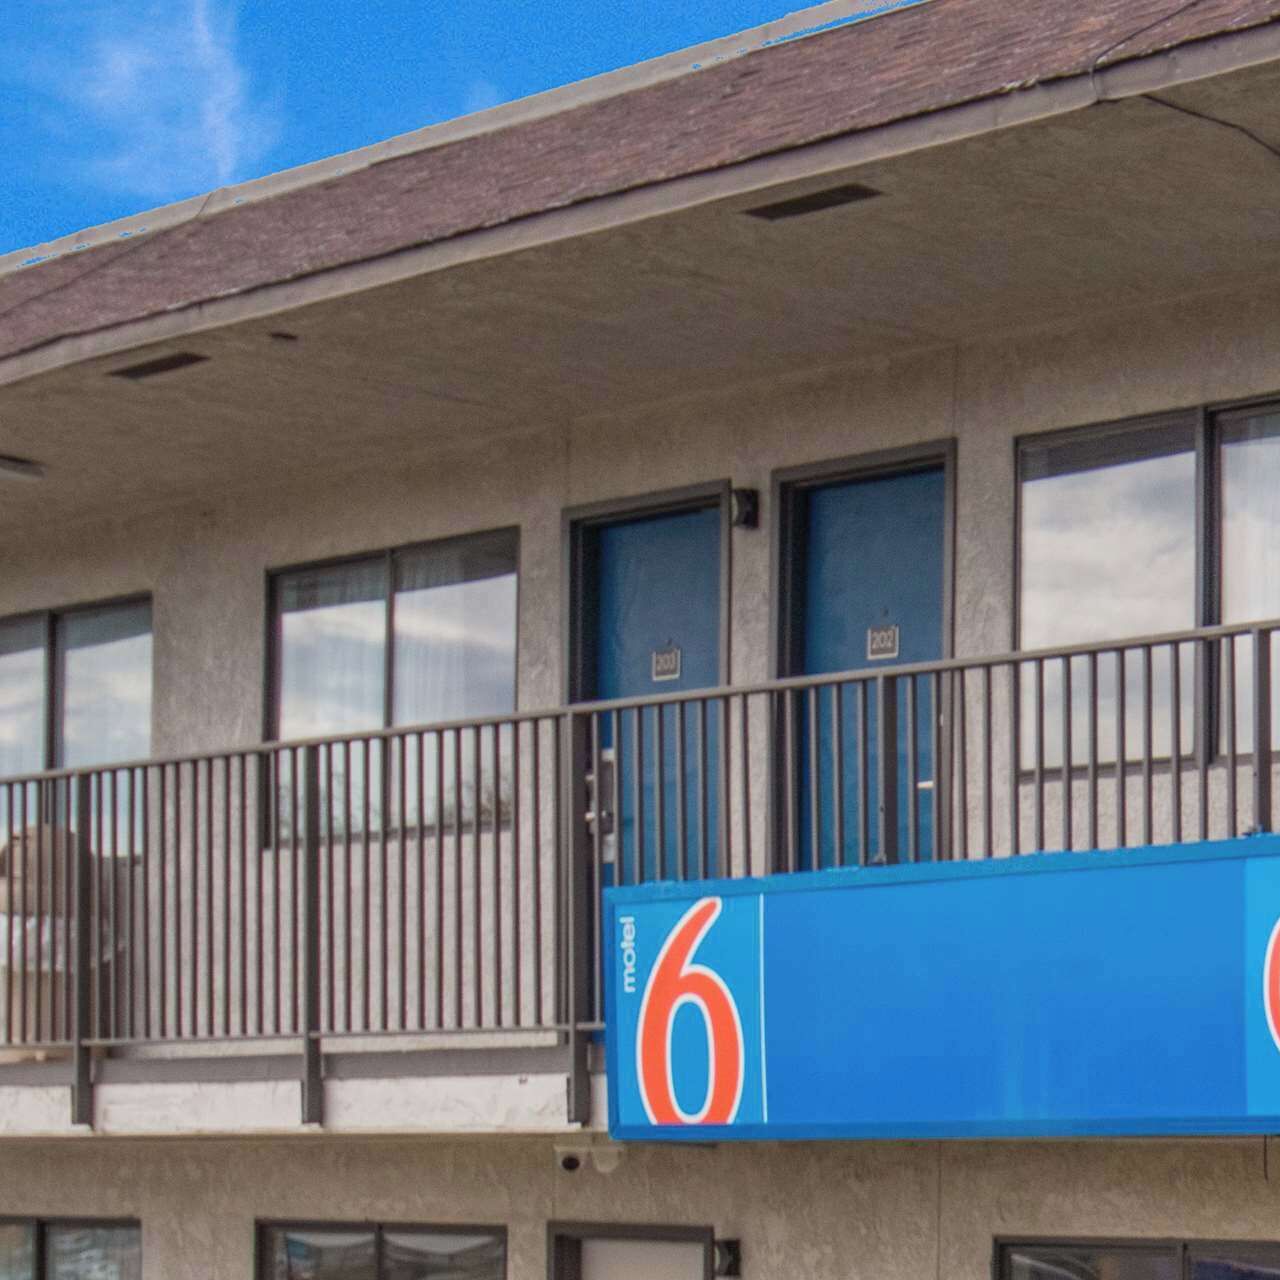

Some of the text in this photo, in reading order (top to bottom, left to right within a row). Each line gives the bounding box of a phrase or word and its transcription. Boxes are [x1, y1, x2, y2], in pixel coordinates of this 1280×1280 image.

[871, 629, 894, 649] 202
[619, 896, 745, 1126] motel 6
